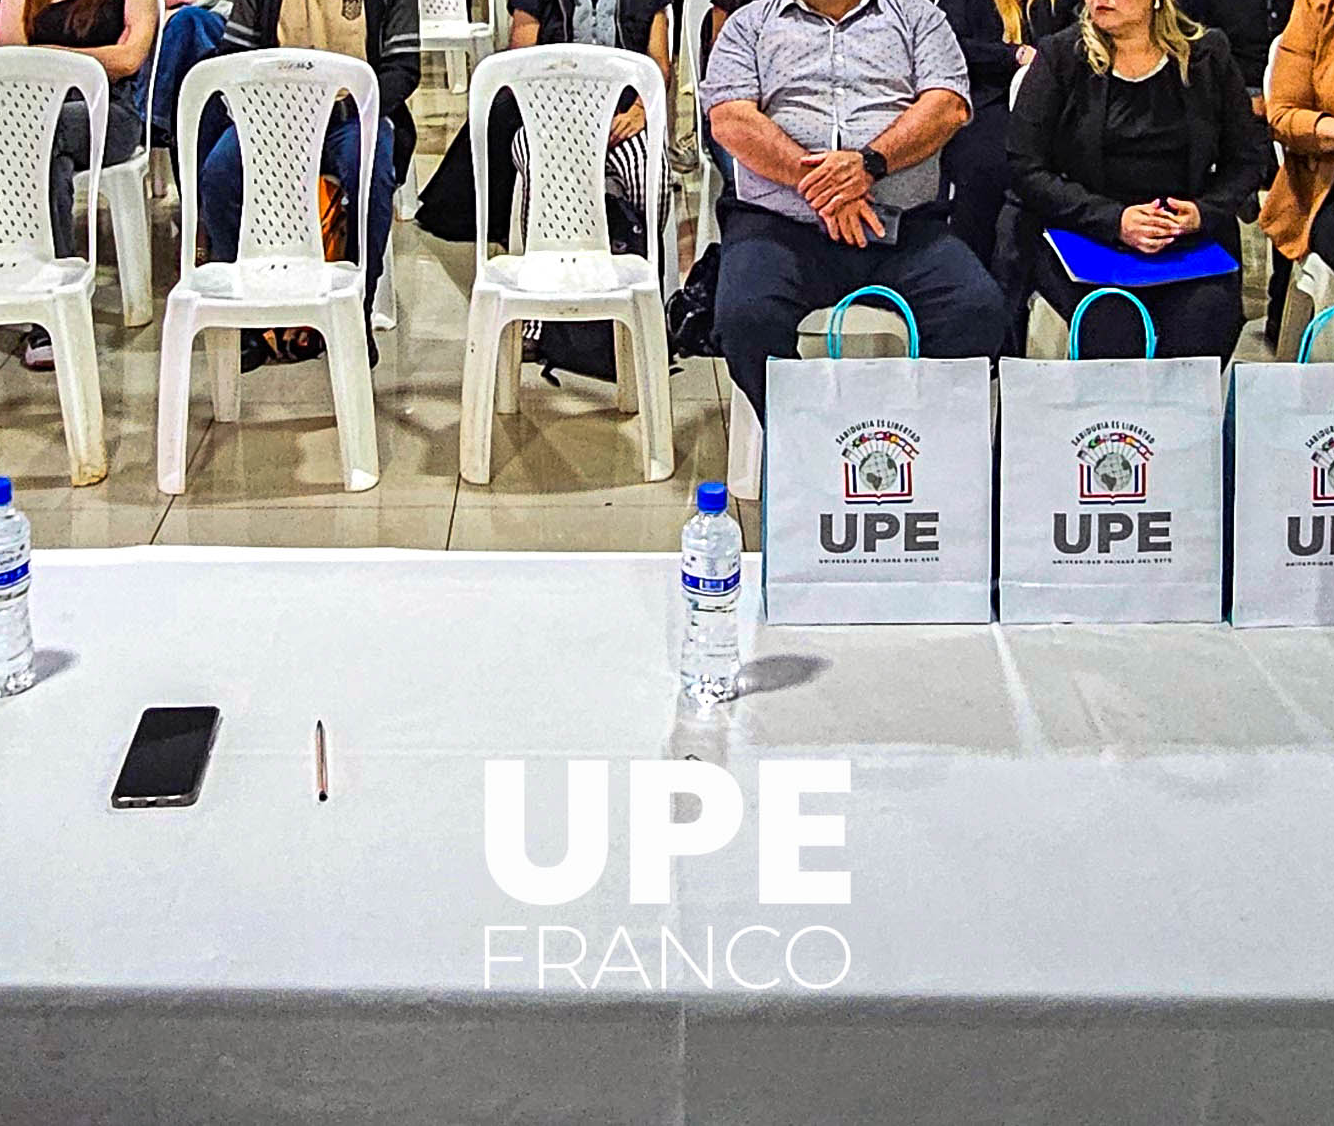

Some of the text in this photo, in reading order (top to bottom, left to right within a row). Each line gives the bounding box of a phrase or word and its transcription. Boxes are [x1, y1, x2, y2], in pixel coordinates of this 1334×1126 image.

[877, 419, 885, 428] ES
[887, 420, 921, 443] LIBERTAD
[1111, 421, 1119, 429] ES
[1122, 421, 1155, 444] LIBERTAD
[820, 512, 939, 553] UPE
[1053, 511, 1172, 554] UPE
